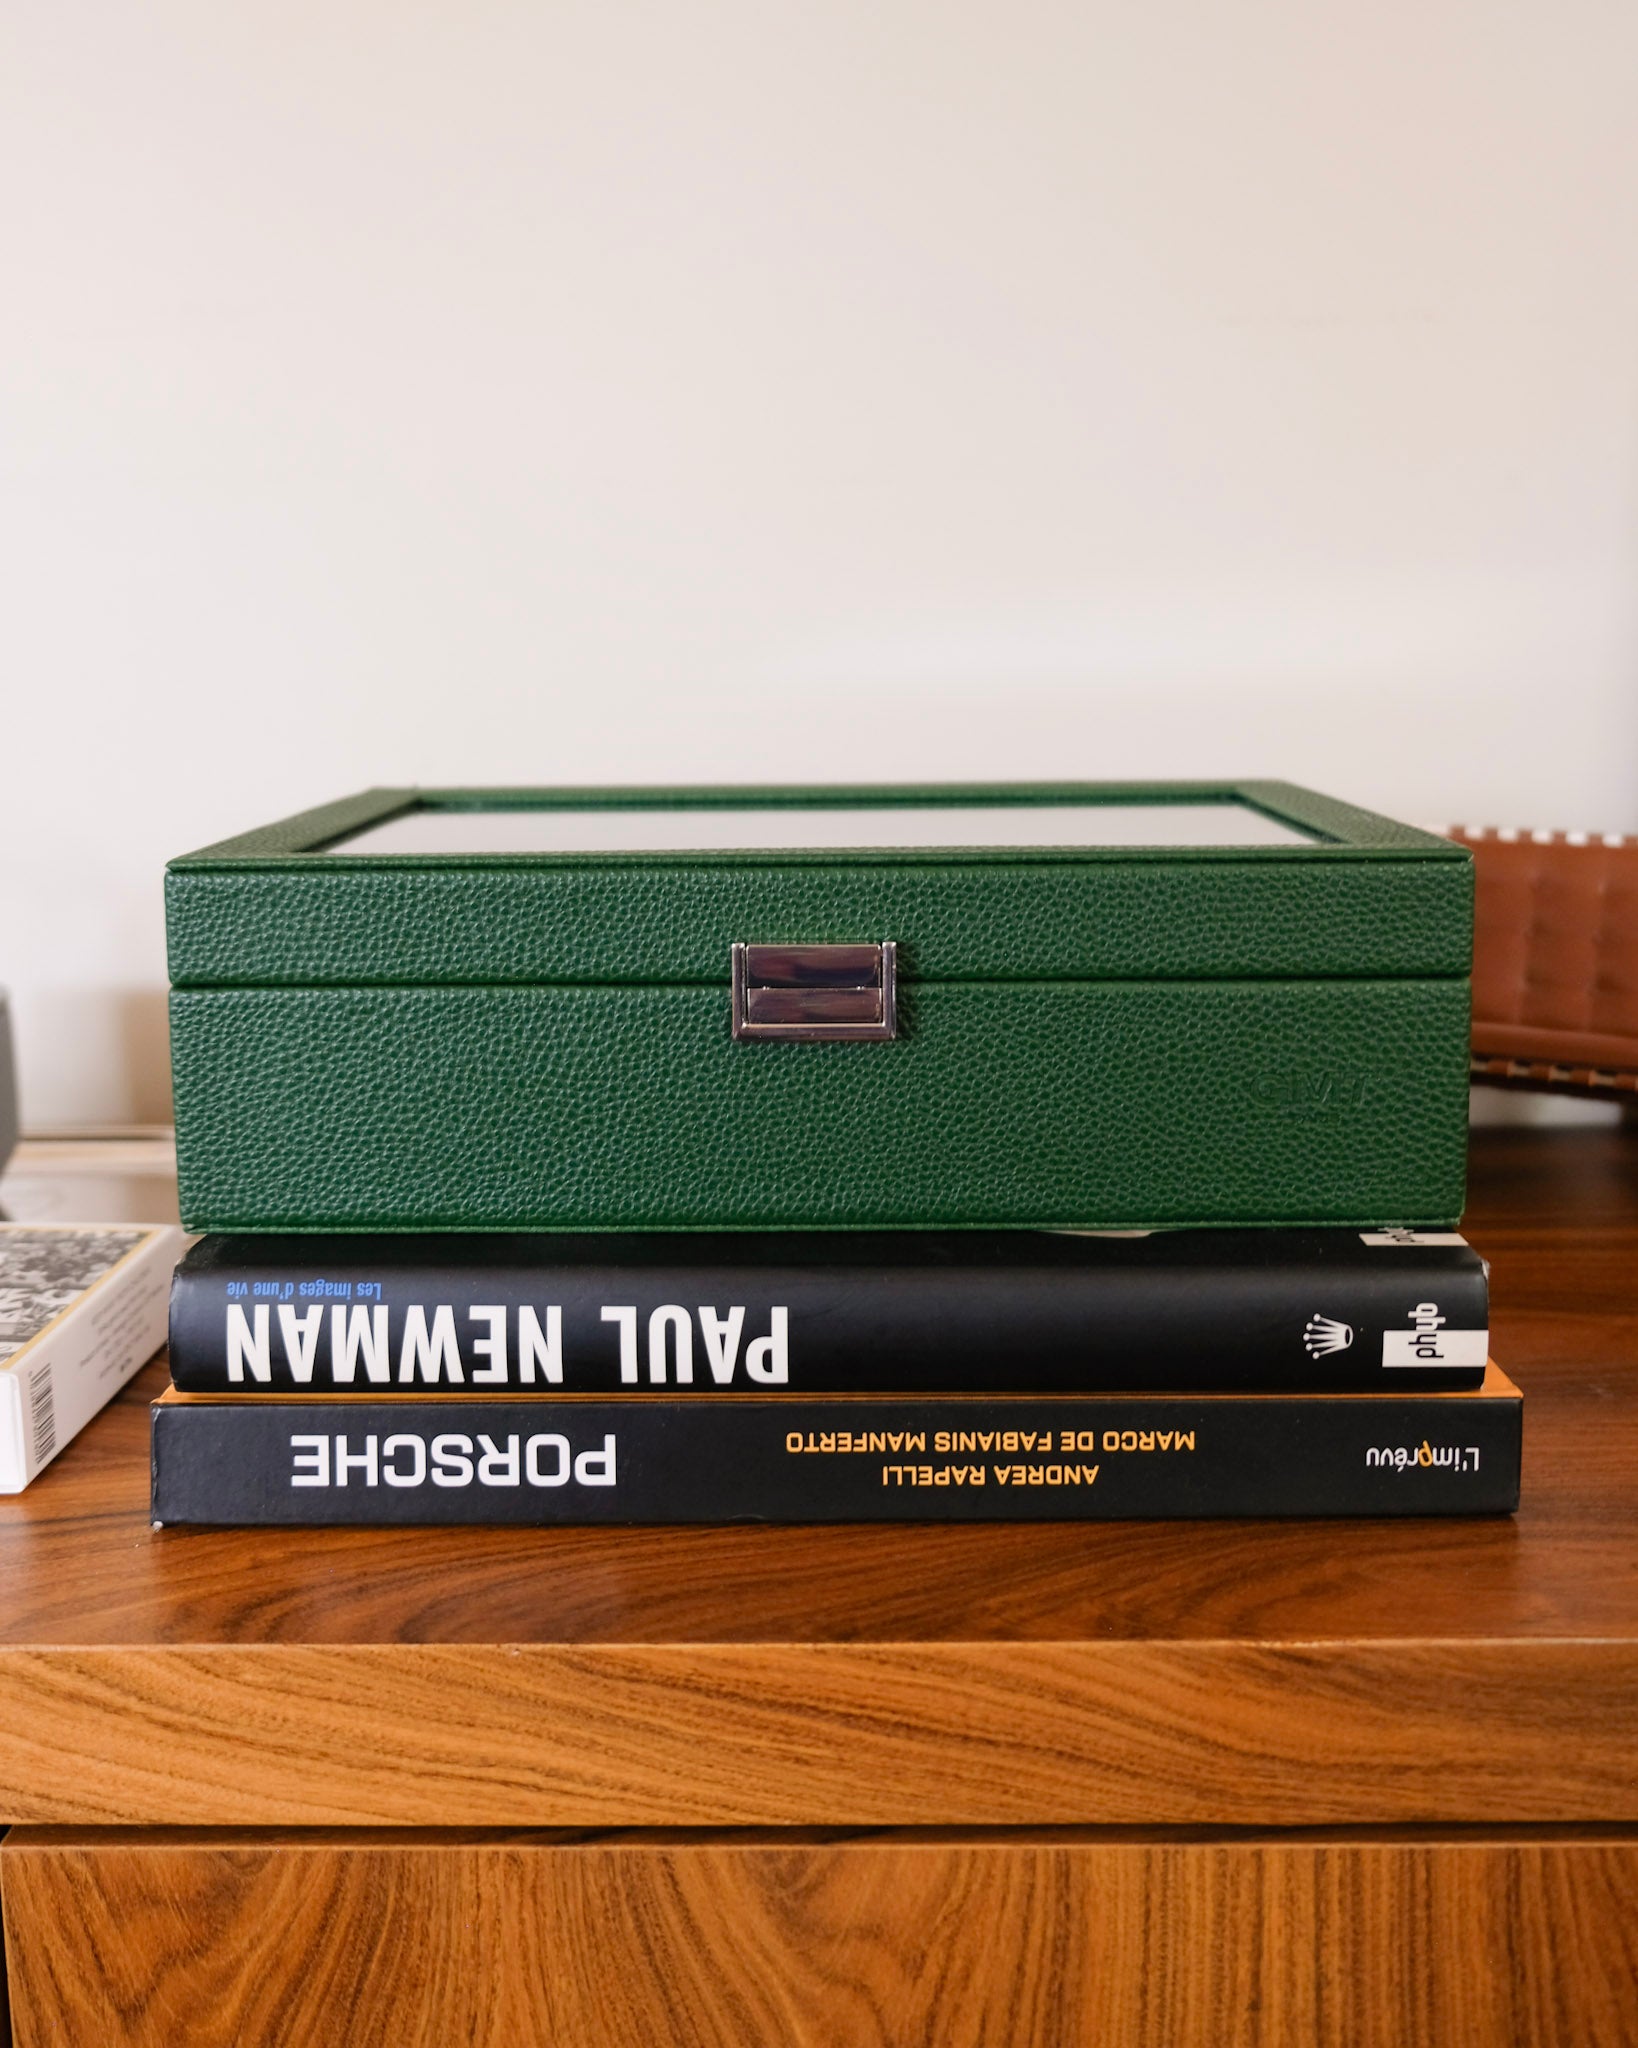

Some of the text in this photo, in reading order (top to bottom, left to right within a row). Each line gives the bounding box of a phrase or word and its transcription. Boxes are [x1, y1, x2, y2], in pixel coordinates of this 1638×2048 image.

[226, 1278, 382, 1300] Les images d'une vie
[225, 1303, 564, 1383] NEWMAN
[601, 1304, 789, 1383] PAUL
[1407, 1302, 1447, 1359] phyb
[290, 1433, 617, 1488] PORSCHE
[785, 1431, 1195, 1453] MARCO DE FABIANIS MANFERTO
[1366, 1440, 1480, 1473] L'imprévu
[882, 1465, 1100, 1486] ANDREA RAPELLI
